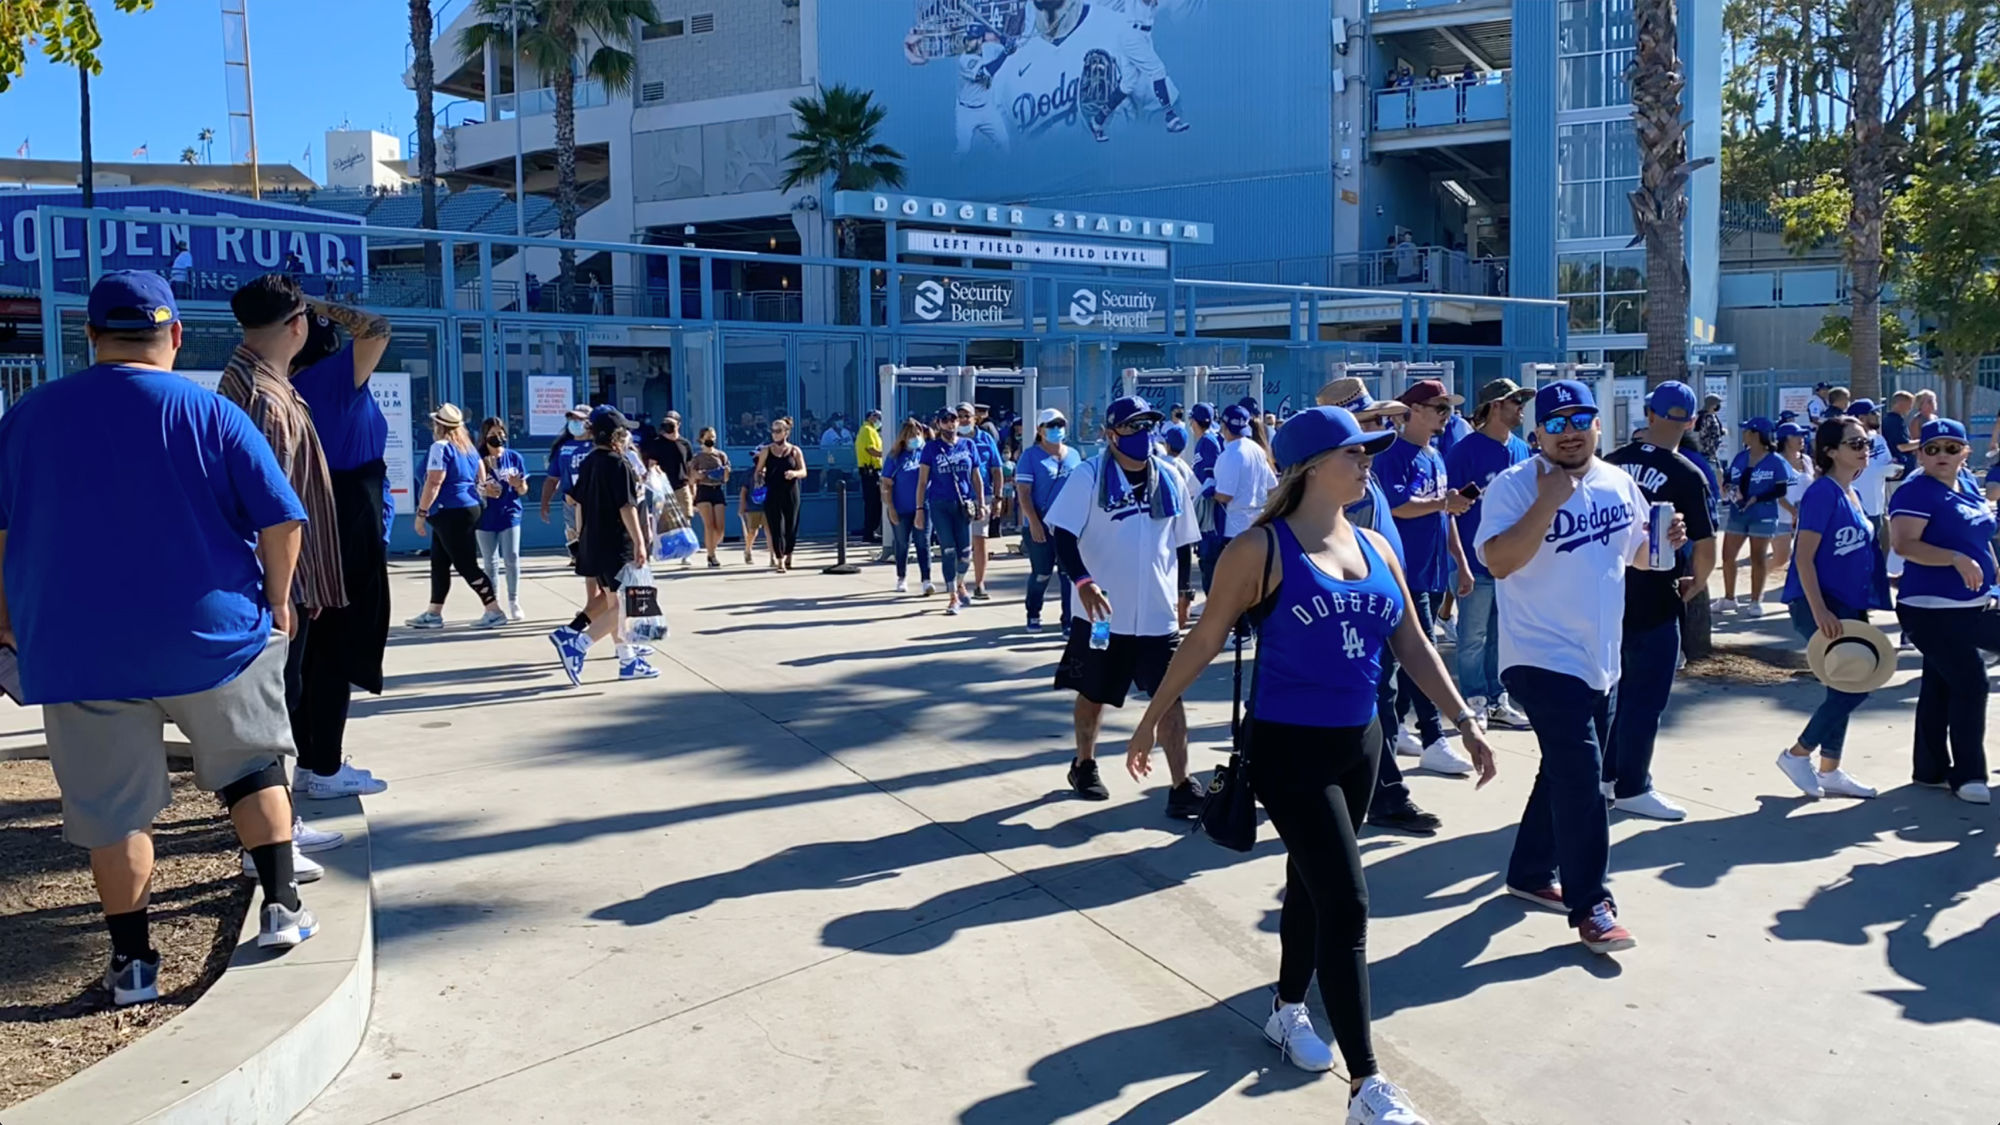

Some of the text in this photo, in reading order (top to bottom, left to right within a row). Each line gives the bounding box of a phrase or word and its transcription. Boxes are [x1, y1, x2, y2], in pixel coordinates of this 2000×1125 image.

[1012, 72, 1081, 130] Dodg
[873, 196, 1199, 239] DODGER STADIUM
[0, 206, 347, 275] OLDEN ROAD
[933, 237, 1146, 262] LEFT FIELD FIELD LEVEL
[950, 281, 1013, 304] Security
[1101, 289, 1156, 311] Security
[951, 300, 1003, 323] Benefit
[1102, 309, 1149, 329] Benefit
[373, 390, 399, 399] GER
[1555, 386, 1573, 402] LA
[1545, 501, 1636, 547] Dodgers
[1291, 591, 1403, 626] DODGERS
[1341, 620, 1366, 659] LA
